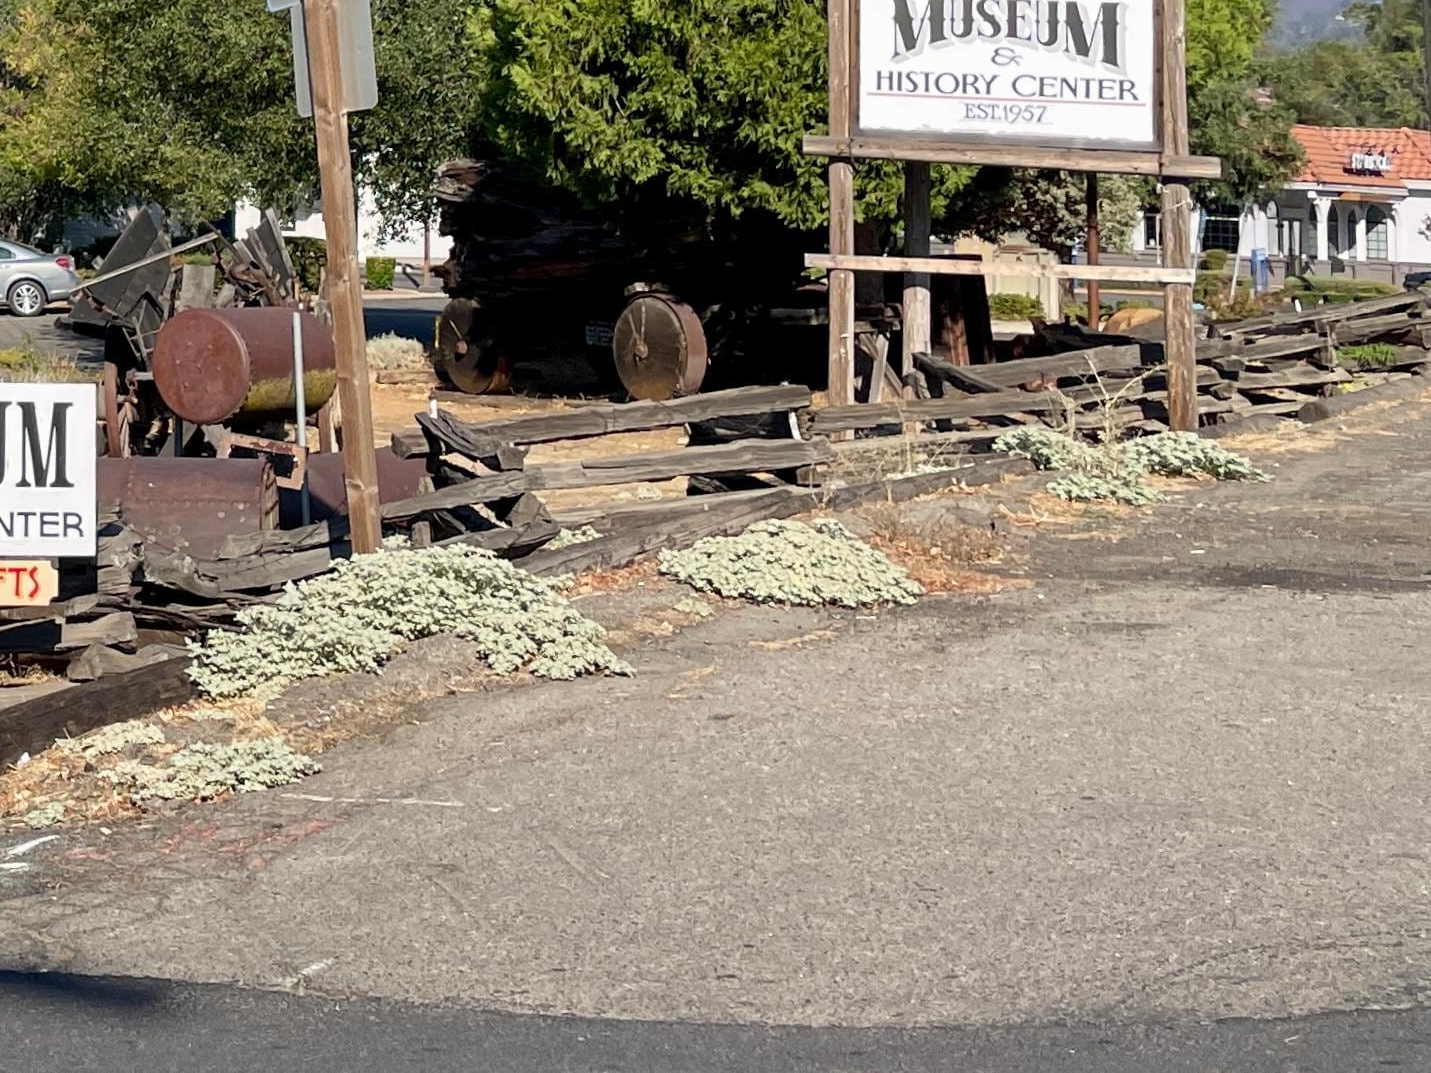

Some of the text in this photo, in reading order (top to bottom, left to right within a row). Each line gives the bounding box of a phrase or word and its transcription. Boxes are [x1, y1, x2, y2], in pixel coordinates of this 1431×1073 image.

[991, 47, 1023, 66] &
[876, 70, 1140, 101] HISTORY CENTER
